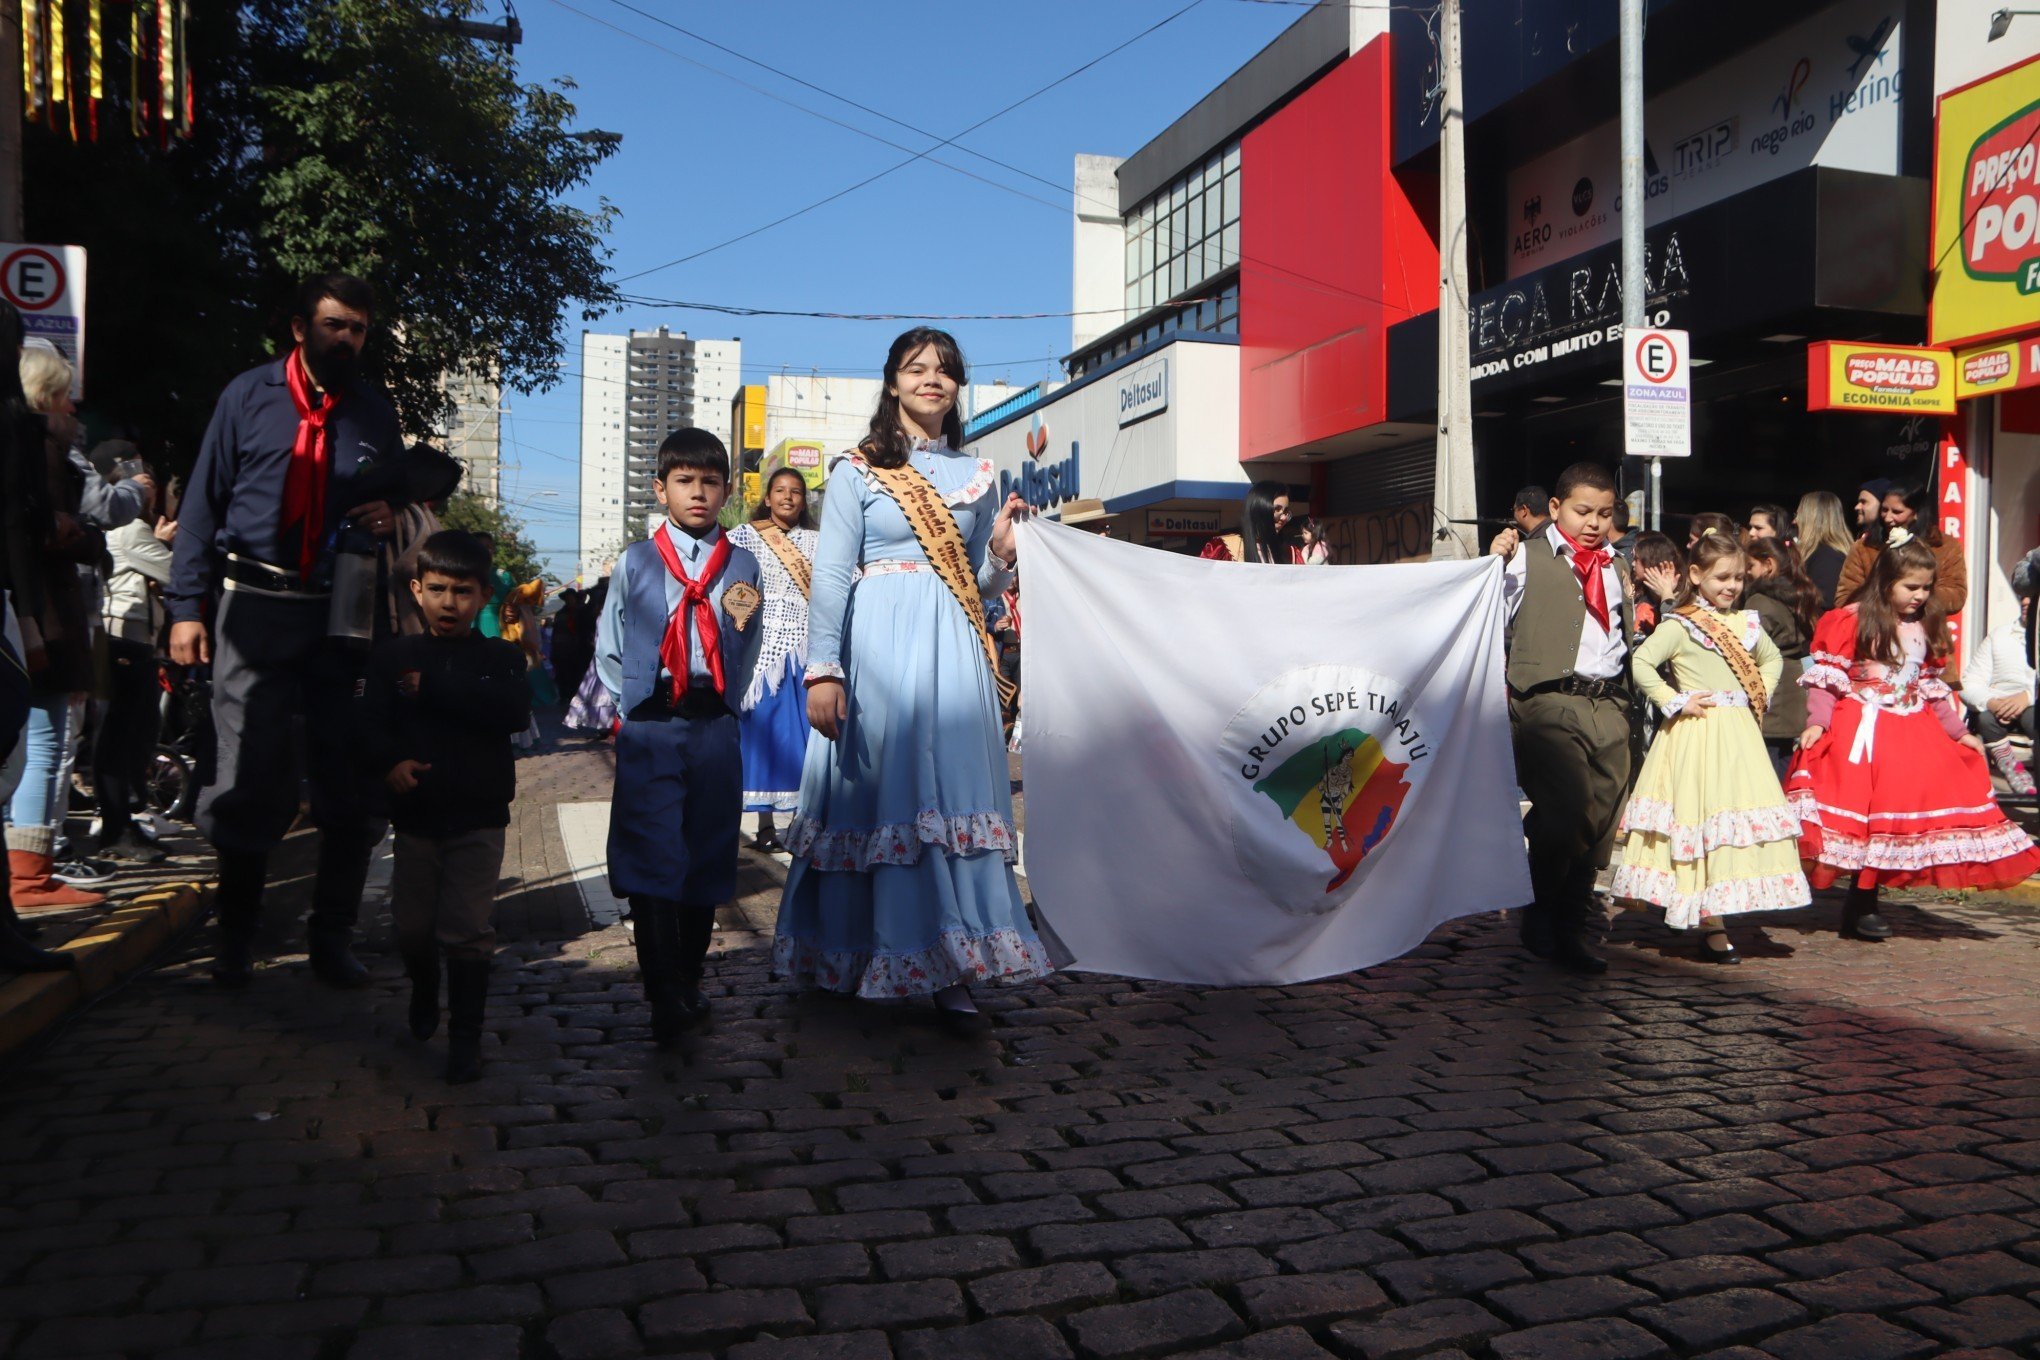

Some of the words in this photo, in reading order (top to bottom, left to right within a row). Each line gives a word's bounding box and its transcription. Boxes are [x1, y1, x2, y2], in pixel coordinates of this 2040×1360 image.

[1829, 69, 1904, 122] Hering
[1675, 124, 1730, 171] TRIP
[1751, 125, 1788, 155] nega
[1970, 143, 2035, 197] PREÇO
[1614, 175, 1669, 213] aas
[1514, 223, 1552, 254] AERO
[1970, 194, 2040, 263] PO
[19, 262, 45, 298] E
[1470, 360, 1510, 382] MODA
[1513, 346, 1549, 369] COM
[1552, 330, 1603, 358] MUITO
[1606, 310, 1670, 342] ESLO
[1648, 344, 1665, 373] E
[1849, 359, 1875, 371] PREÇO
[1875, 358, 1935, 374] MAIS
[1850, 370, 1936, 386] POPULAR
[1121, 372, 1162, 413] Deltasul
[1629, 388, 1657, 398] ZONA
[1658, 389, 1685, 399] AZUL
[1843, 393, 1912, 406] ECONOMIA
[1000, 440, 1080, 512] Deltasul
[1166, 518, 1219, 530] Deltasul
[1241, 705, 1307, 780] GRUPO
[1311, 686, 1360, 717] SEPÉ
